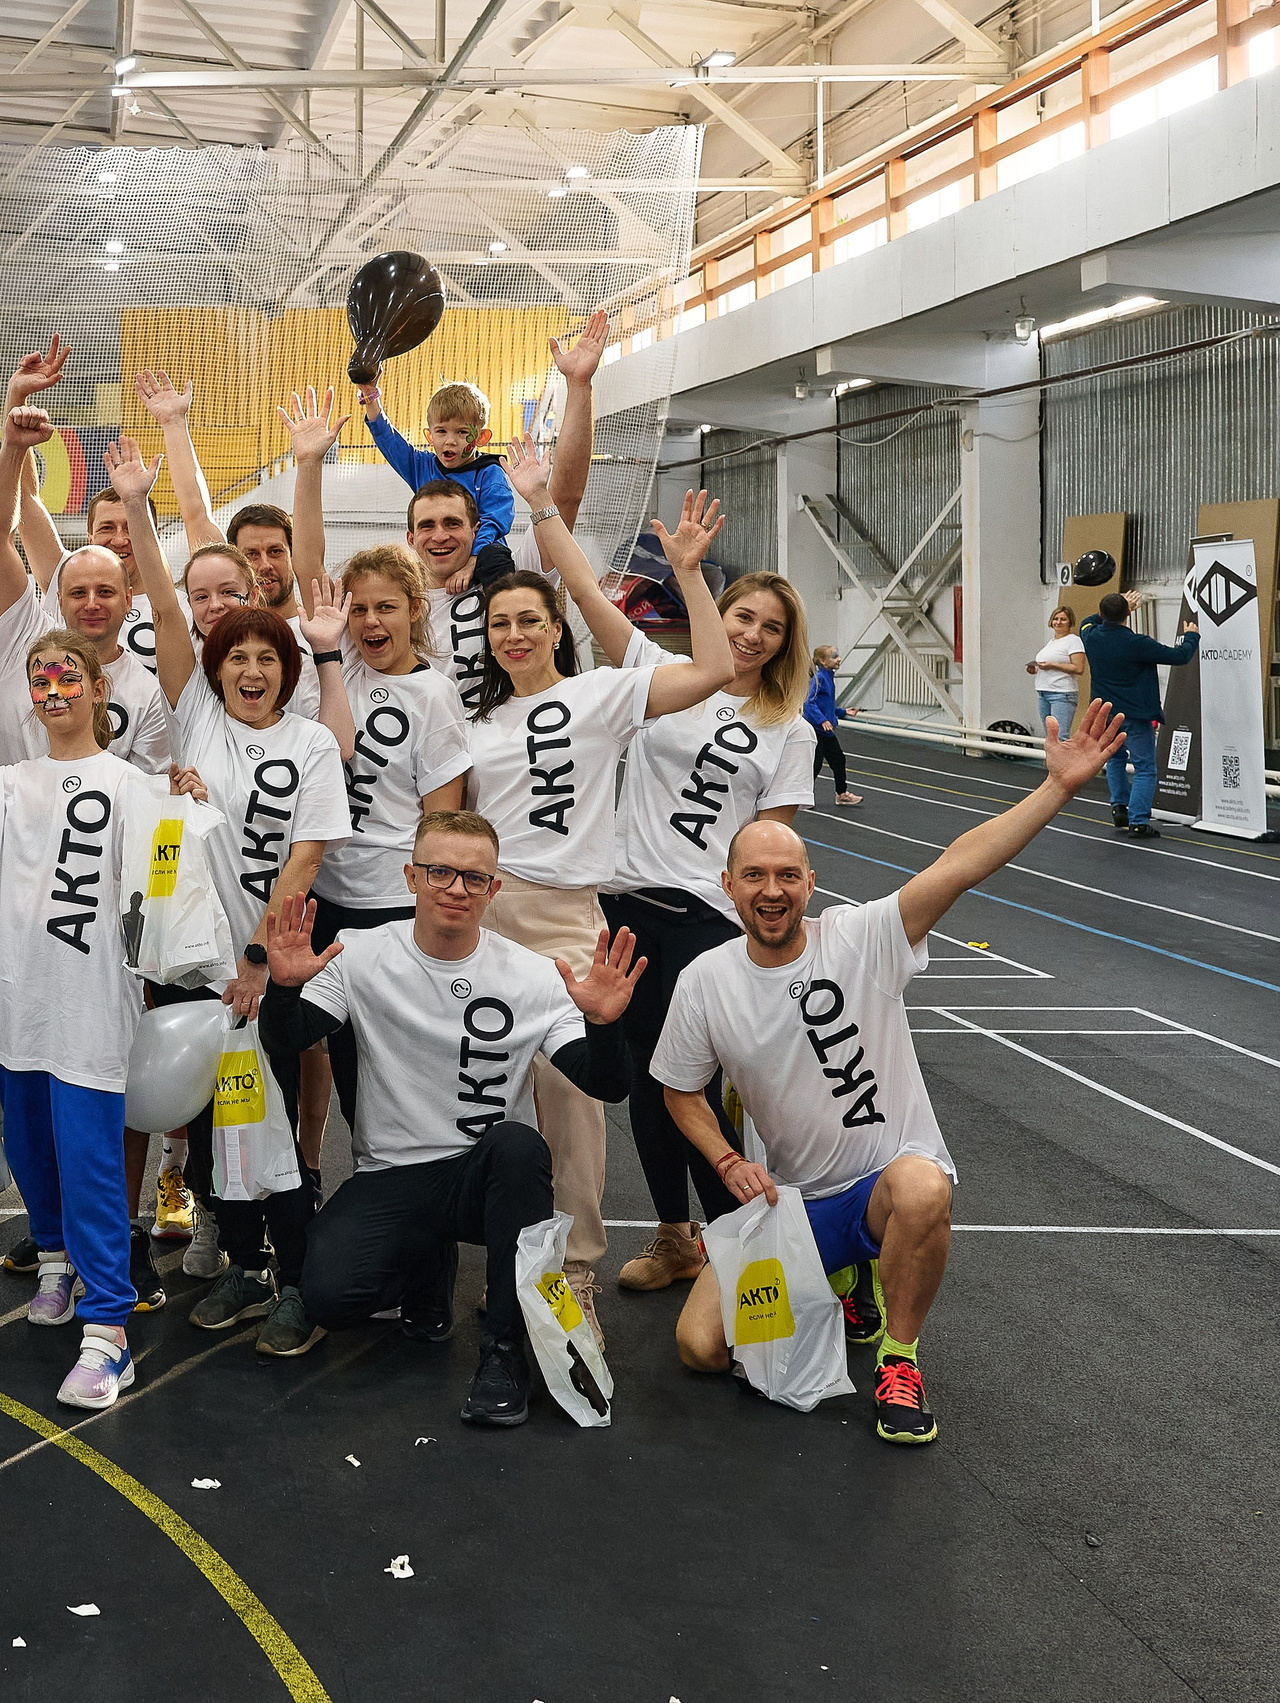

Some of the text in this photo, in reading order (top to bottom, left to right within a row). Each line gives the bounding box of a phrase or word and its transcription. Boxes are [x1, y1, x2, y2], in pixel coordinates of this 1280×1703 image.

[240, 759, 299, 904] АКТО
[527, 701, 574, 836] АКТО
[670, 721, 758, 851] АКТО
[47, 790, 111, 955] АКТО
[153, 845, 180, 861] КТ
[456, 997, 514, 1138] АКТО
[800, 979, 886, 1128] АКТО
[547, 1279, 566, 1305] ТО
